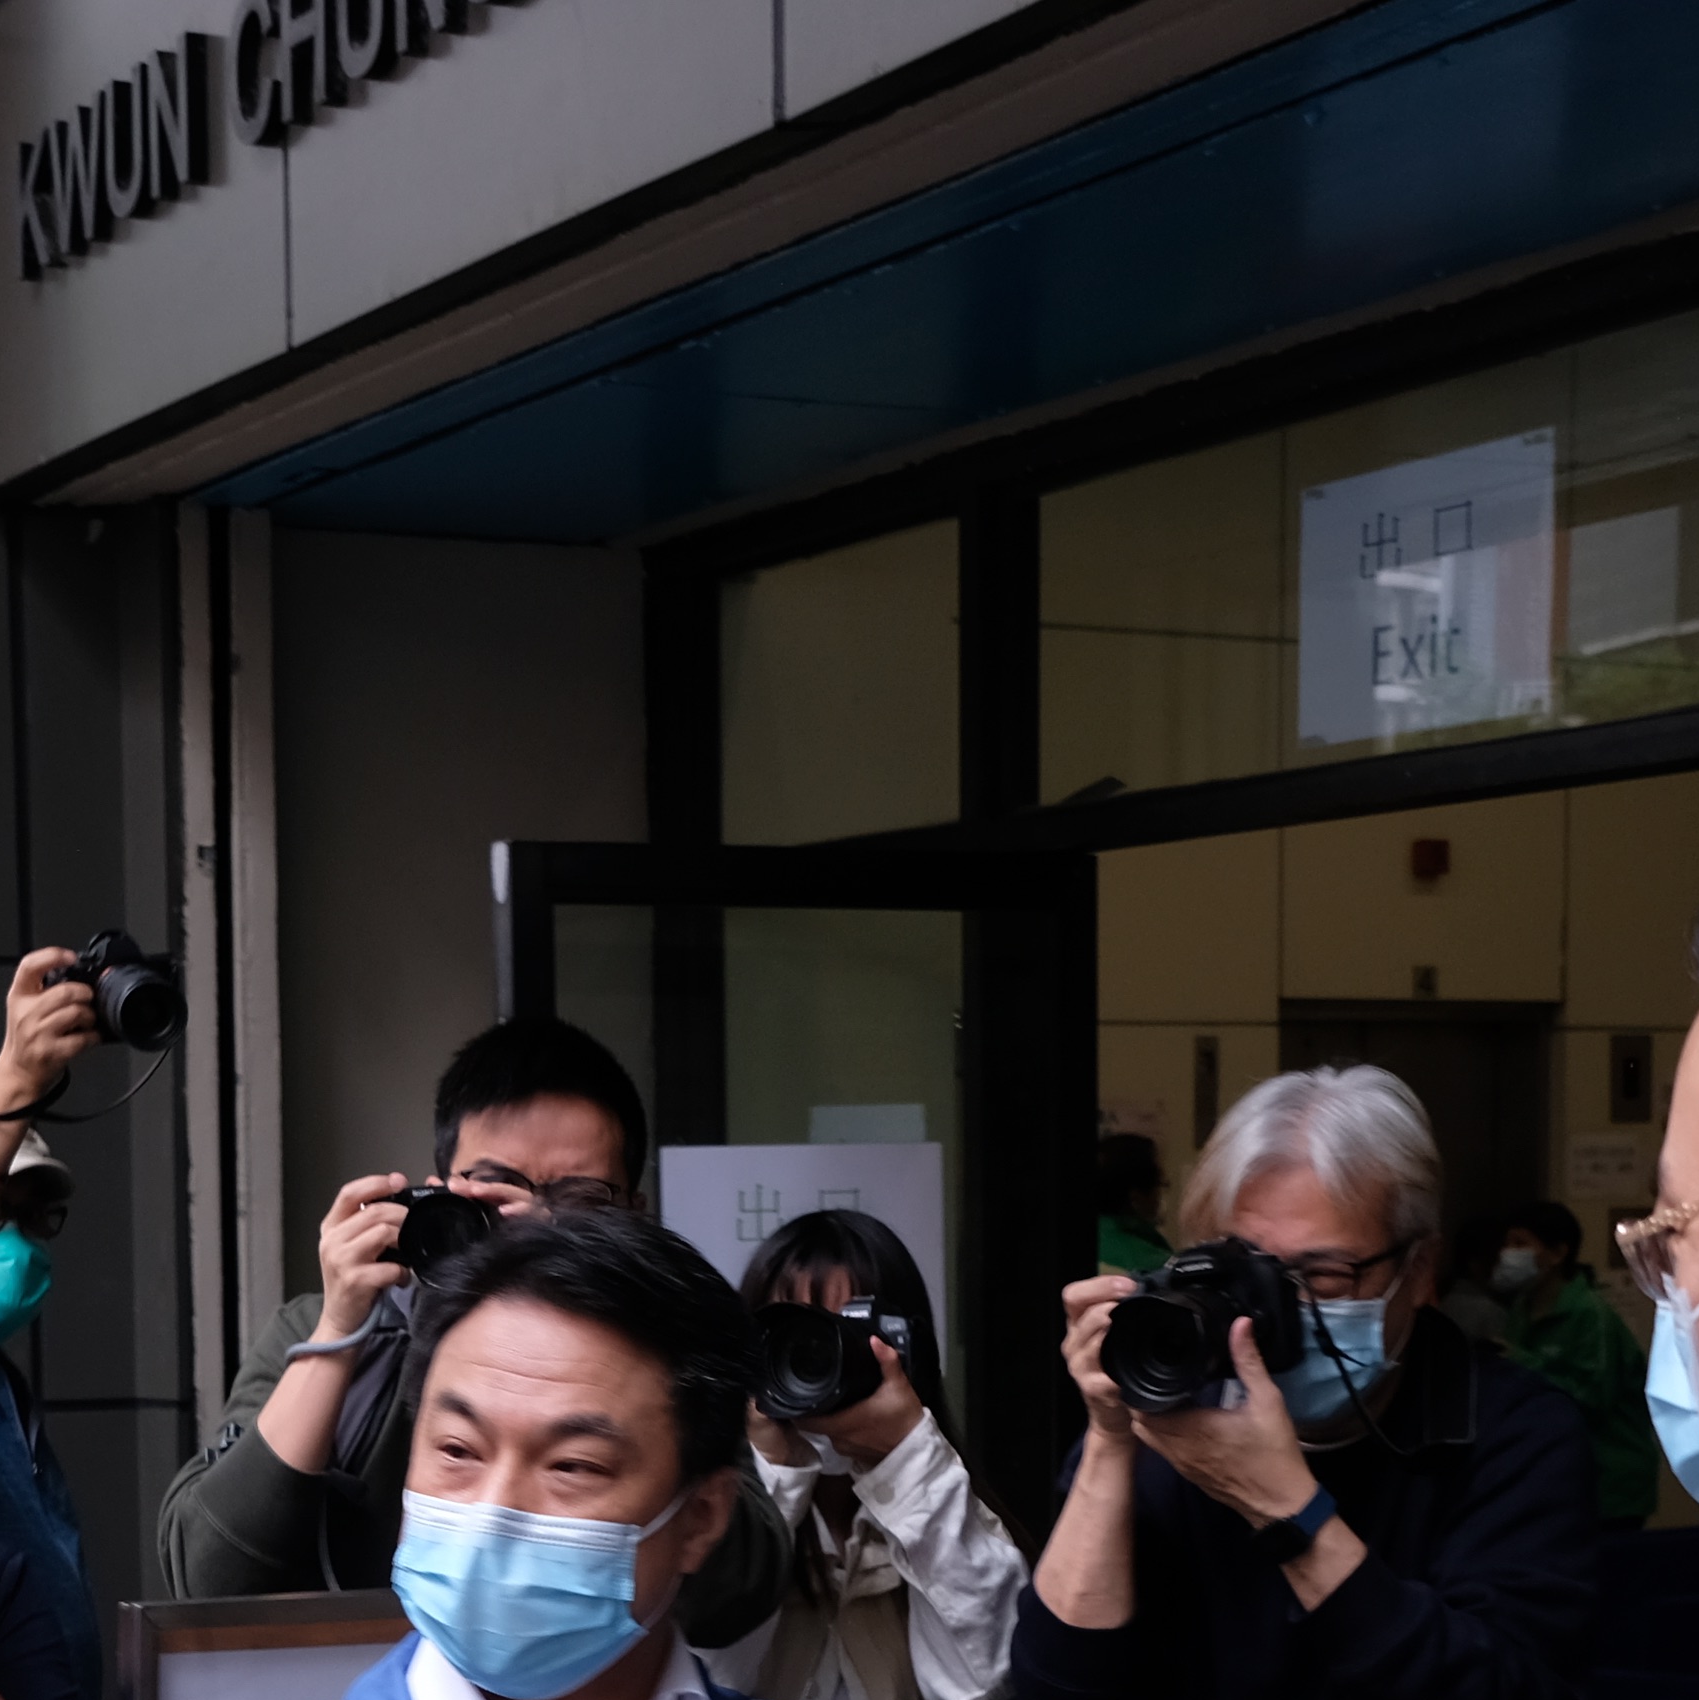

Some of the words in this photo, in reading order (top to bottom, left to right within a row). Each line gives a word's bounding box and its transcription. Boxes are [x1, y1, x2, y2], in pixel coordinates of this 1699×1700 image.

[20, 33, 206, 280] KWUN
[232, 0, 522, 146] CHU
[1360, 501, 1473, 580] 出口
[1372, 615, 1462, 687] Exit
